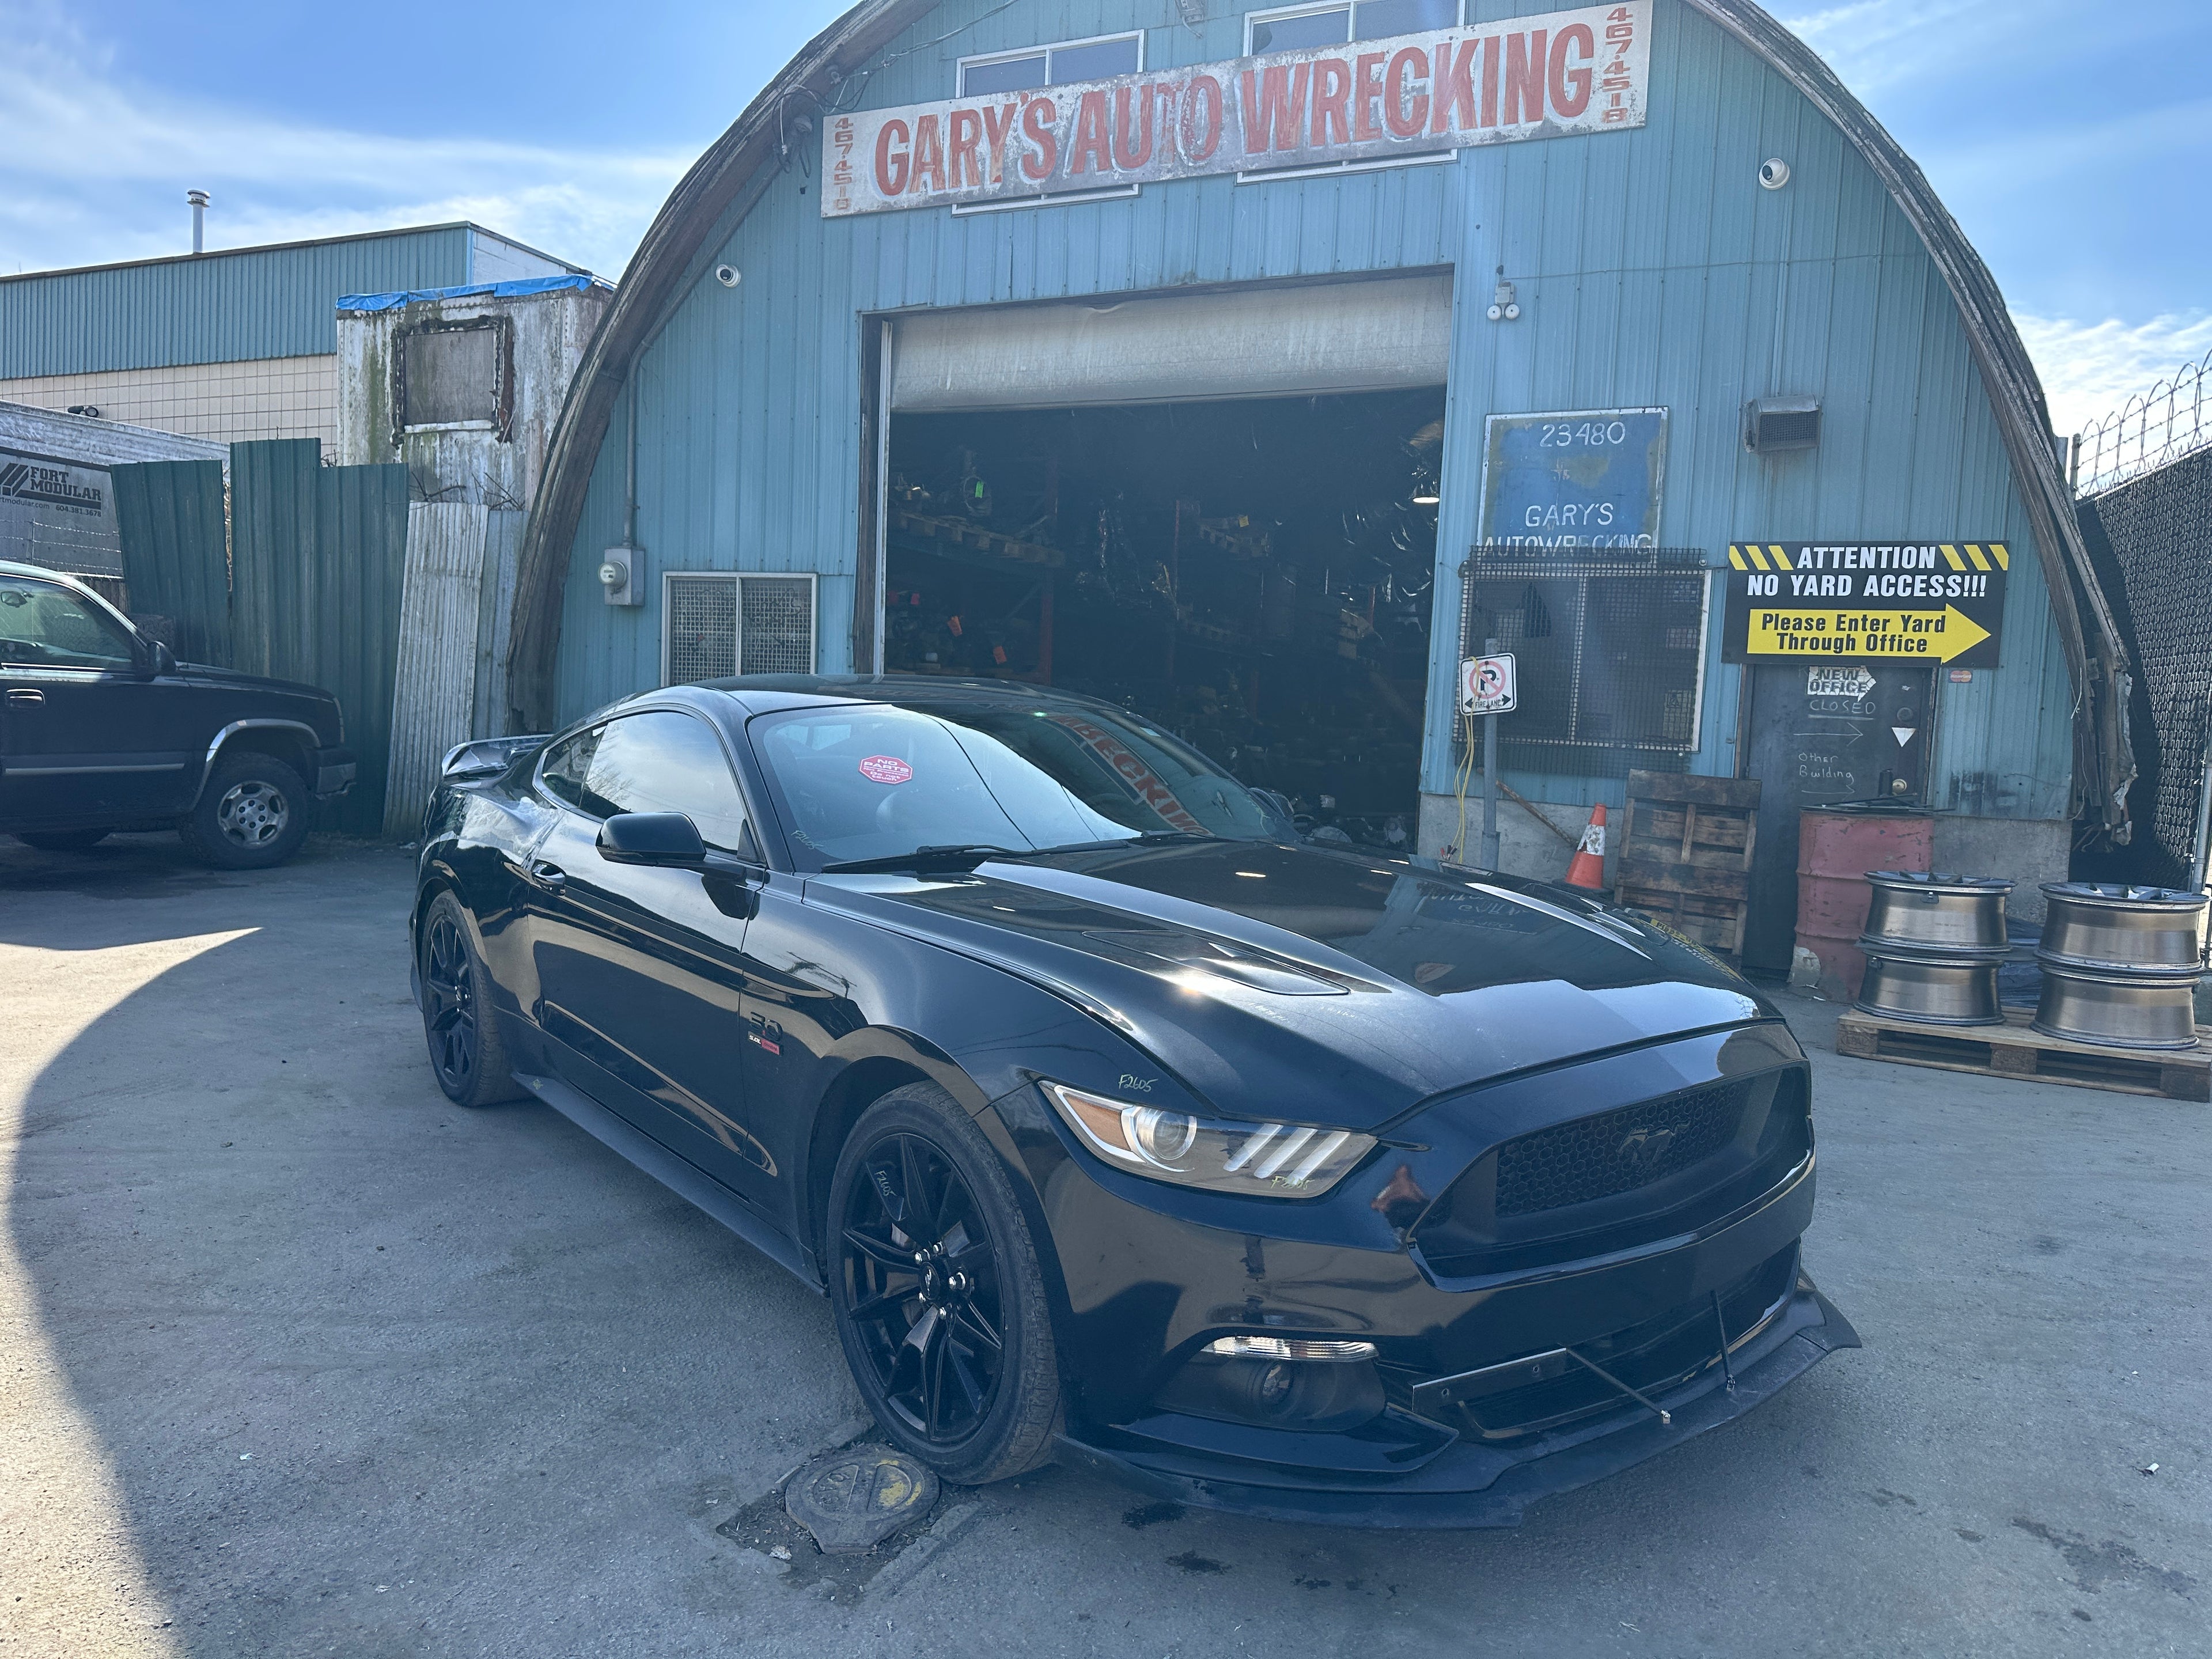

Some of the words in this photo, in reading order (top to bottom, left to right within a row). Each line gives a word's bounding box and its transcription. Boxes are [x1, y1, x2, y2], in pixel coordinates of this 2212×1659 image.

[875, 92, 1056, 196] GARY'S
[1071, 75, 1222, 173] AUTO
[1241, 23, 1594, 154] WRECKING
[1540, 421, 1626, 447] 23480
[31, 466, 69, 483] FORT
[31, 479, 101, 501] MODULAR
[56, 505, 101, 517] 604.381.3678
[1525, 503, 1613, 527] GARY'S
[1797, 546, 1936, 569] ATTENTION
[1747, 575, 1779, 596] NO
[1791, 575, 1852, 596] YARD
[1863, 575, 1987, 597] ACCESS!!!
[1762, 613, 1826, 631] Please
[1836, 613, 1891, 632] Enter
[1901, 615, 1946, 633] Yard
[1777, 632, 1856, 654] Through
[1865, 634, 1927, 653] Office
[1819, 668, 1859, 680] NEW
[1809, 680, 1868, 693] OFFICE
[1475, 700, 1486, 709] FIRE
[1809, 699, 1876, 714] CLOSED
[864, 762, 909, 772] PARTS
[1799, 764, 1854, 784] Building
[1118, 1074, 1158, 1092] F2605
